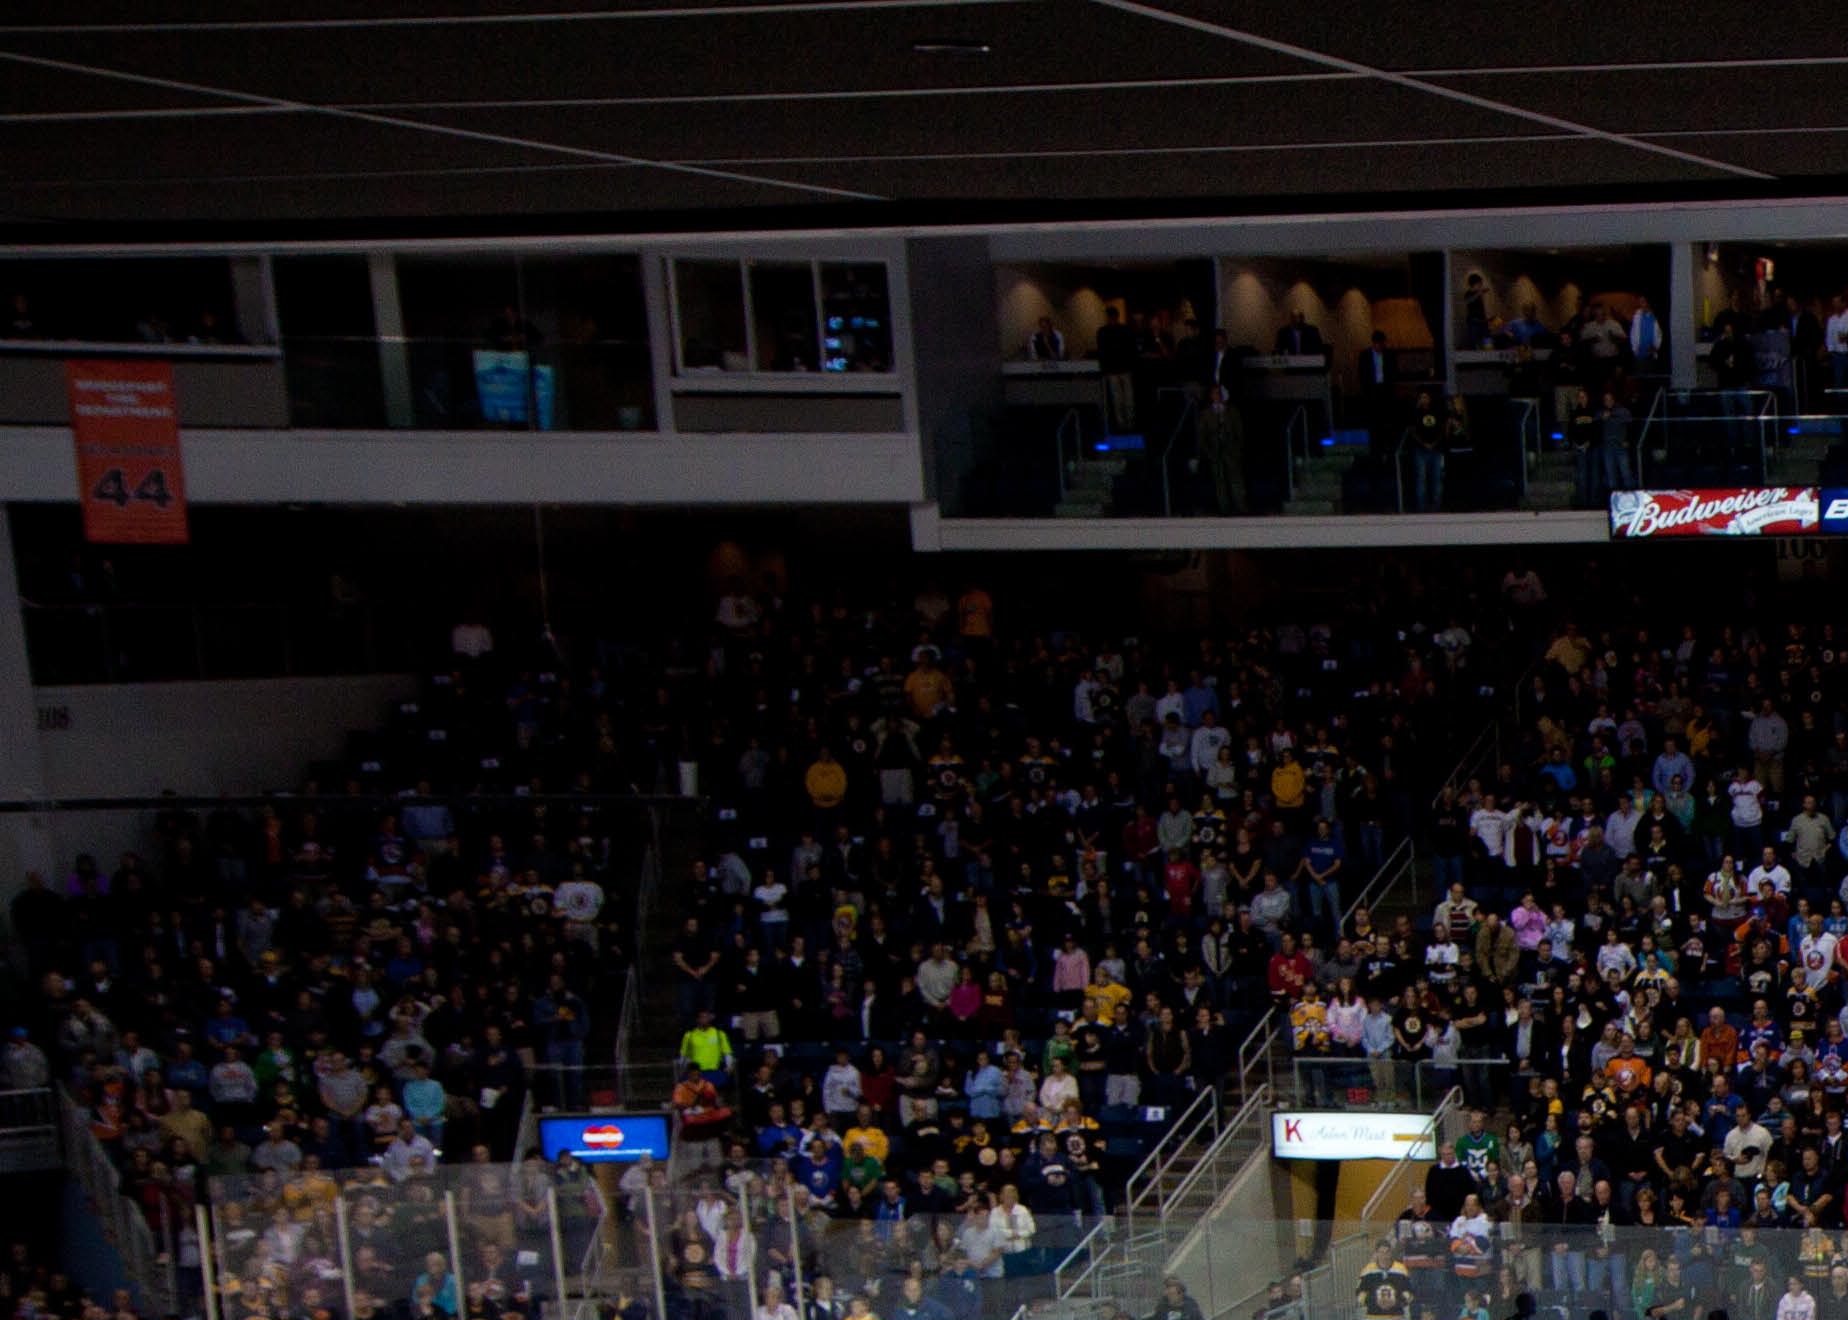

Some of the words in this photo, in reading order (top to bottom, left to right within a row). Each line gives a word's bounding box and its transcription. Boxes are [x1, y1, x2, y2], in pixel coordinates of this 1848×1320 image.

[94, 469, 172, 508] 44
[1630, 488, 1788, 537] Budweiser
[1285, 1120, 1303, 1142] K
